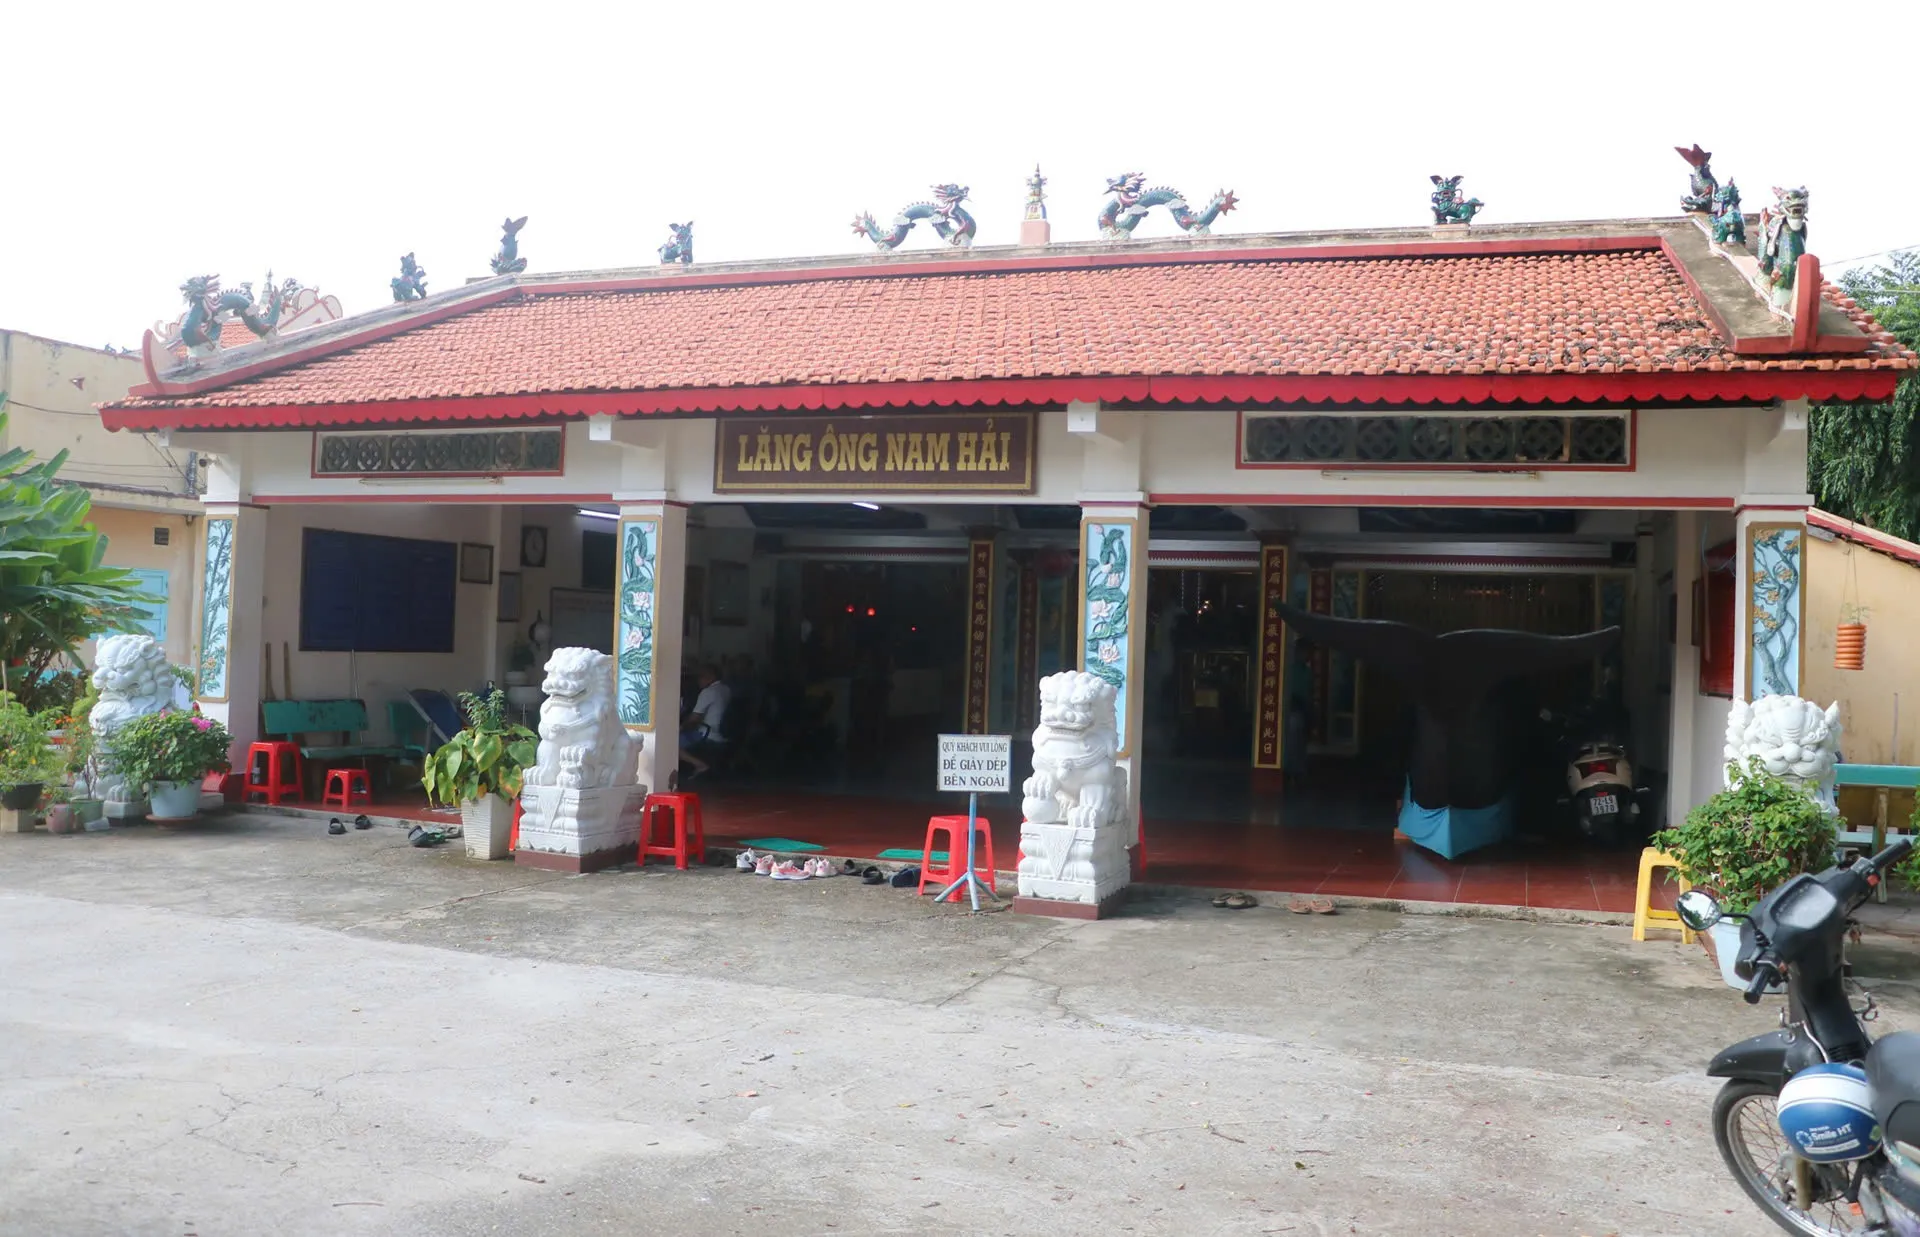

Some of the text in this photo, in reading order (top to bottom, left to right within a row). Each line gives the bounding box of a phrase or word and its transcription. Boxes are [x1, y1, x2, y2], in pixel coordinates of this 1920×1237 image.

[738, 418, 1011, 472] LĂNG ÔNG NAM HẢI
[957, 740, 977, 752] KHÁCH
[979, 743, 990, 752] VUI
[943, 753, 957, 770] ĐỂ
[944, 773, 1005, 787] BÊN NGOÀI
[1811, 1130, 1838, 1141] Smile
[1837, 1123, 1852, 1136] HT
